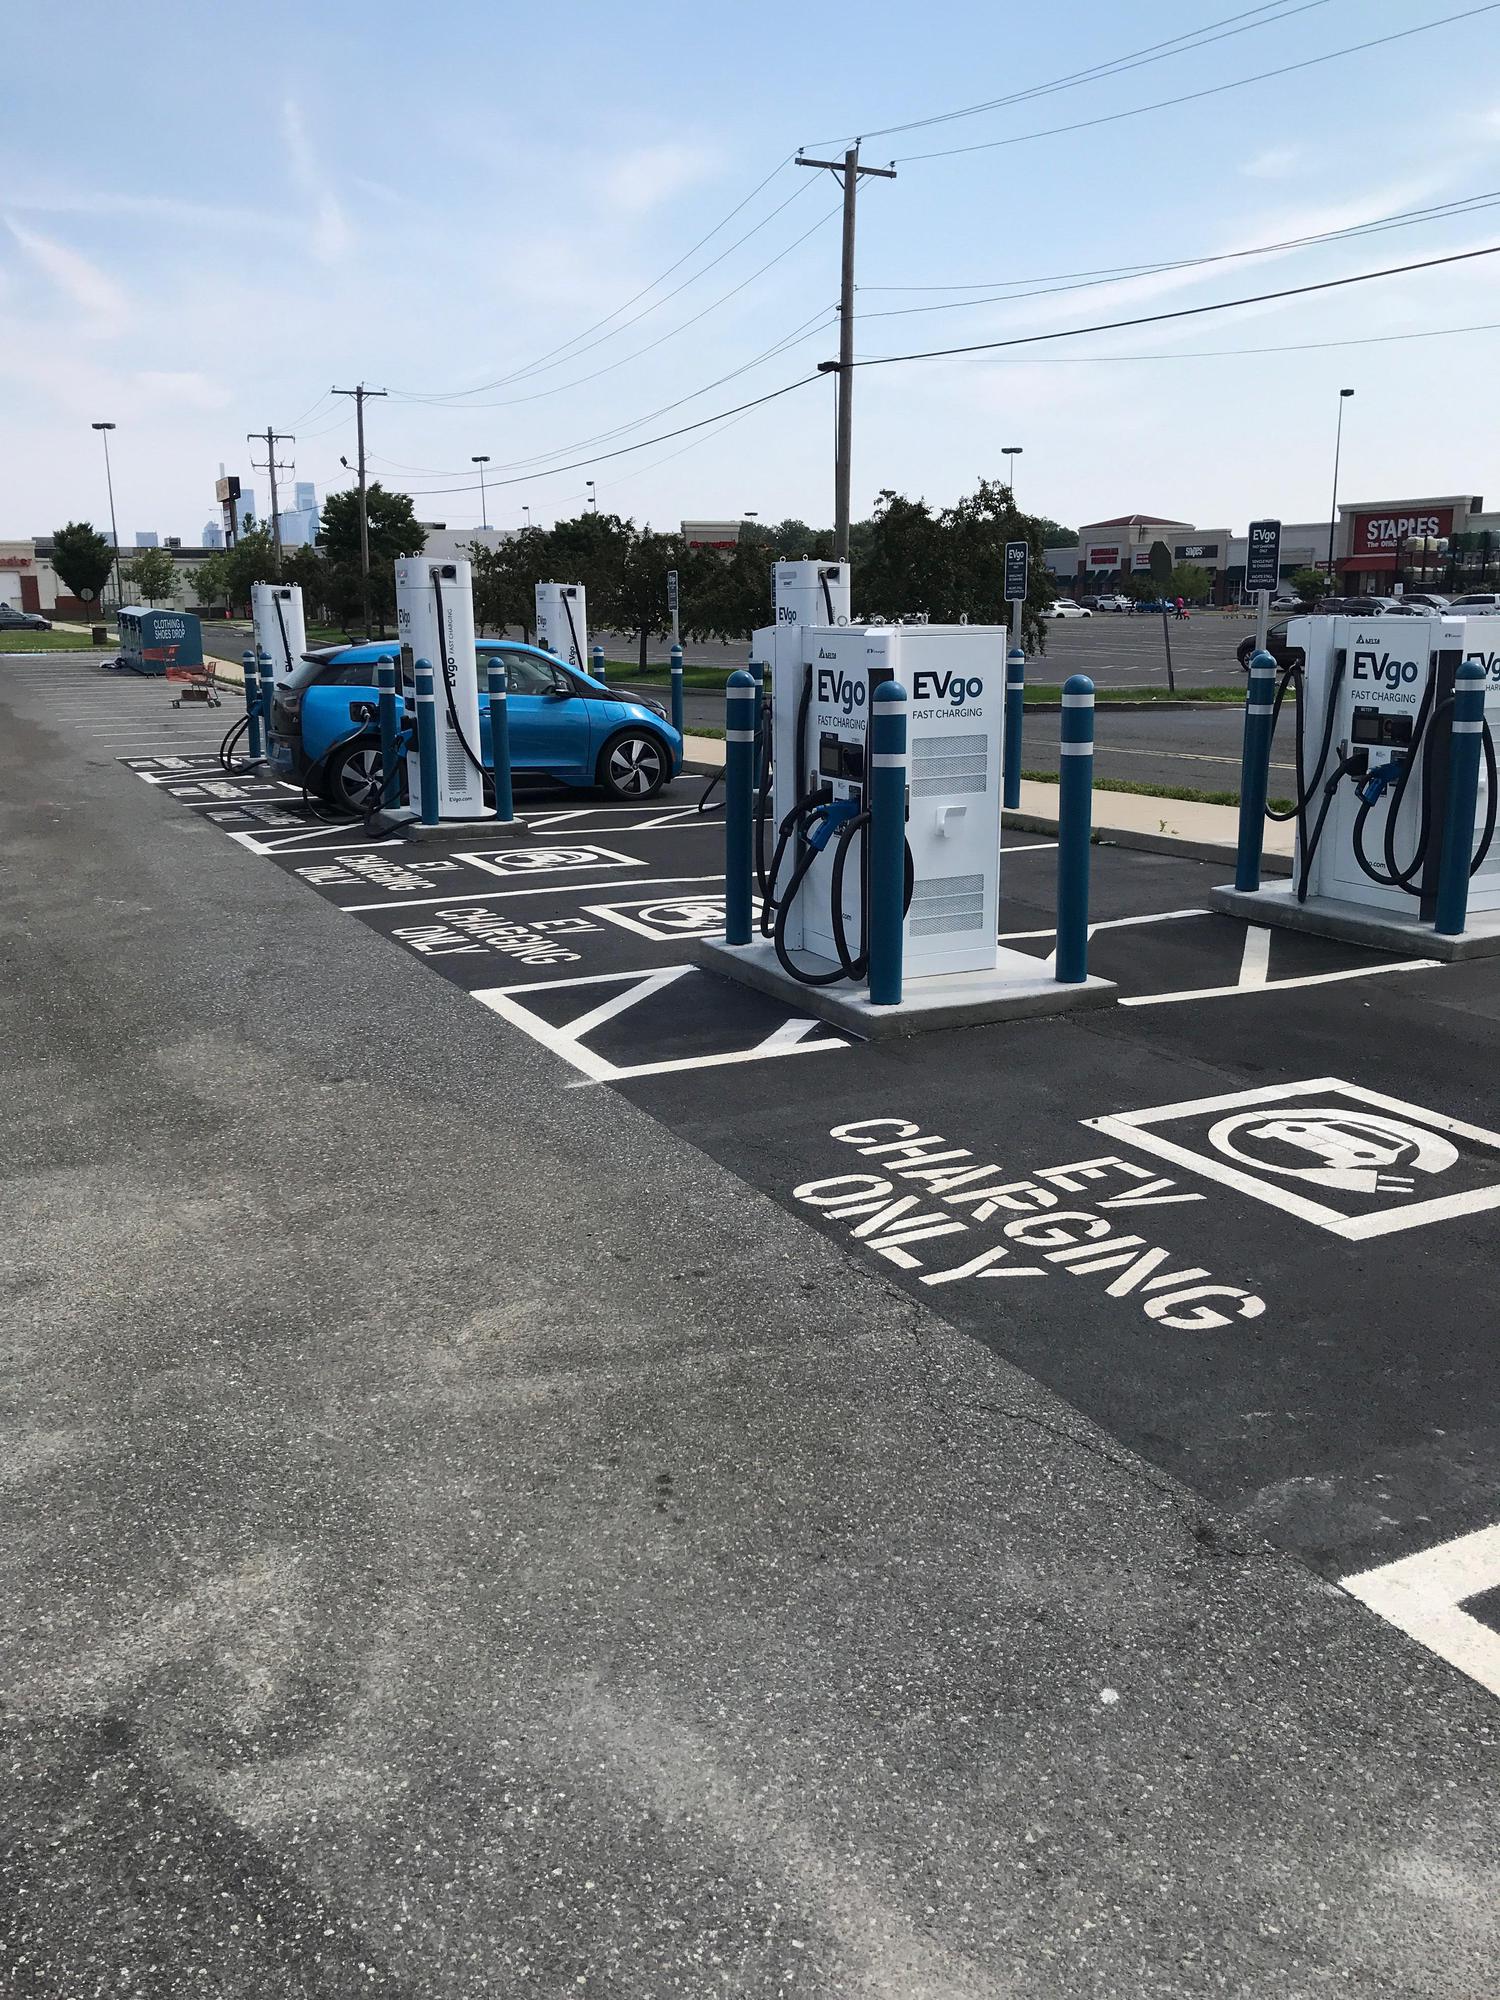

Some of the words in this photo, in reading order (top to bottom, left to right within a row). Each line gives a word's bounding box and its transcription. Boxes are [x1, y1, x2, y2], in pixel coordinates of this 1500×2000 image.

[1253, 529, 1276, 543] EVgo
[1367, 517, 1439, 540] STAPLES
[1008, 549, 1025, 561] EVgo
[153, 618, 180, 629] CLOTHING
[399, 608, 411, 627] EVgo
[779, 607, 797, 624] EVgo
[155, 629, 171, 639] SHOES
[171, 629, 186, 639] DROP
[1353, 651, 1418, 690] EVgo
[1467, 651, 1500, 682] Vg
[818, 669, 865, 714] EVgo
[913, 671, 983, 706] EVgo
[1351, 690, 1371, 700] FAST
[1371, 691, 1416, 704] CHARGING
[817, 715, 833, 727] FAST
[832, 717, 866, 731] CHARGING
[912, 710, 934, 719] FAST
[935, 708, 983, 719] CHARGING
[294, 865, 367, 886] ONLY
[334, 854, 437, 891] CHARGING
[405, 860, 464, 872] EV
[434, 907, 582, 965] CHARGING
[528, 917, 606, 935] EV
[391, 925, 490, 956] ONLY
[1032, 1155, 1208, 1209] EV
[792, 1174, 1049, 1286] ONLY
[829, 1118, 1267, 1330] CHARGING
